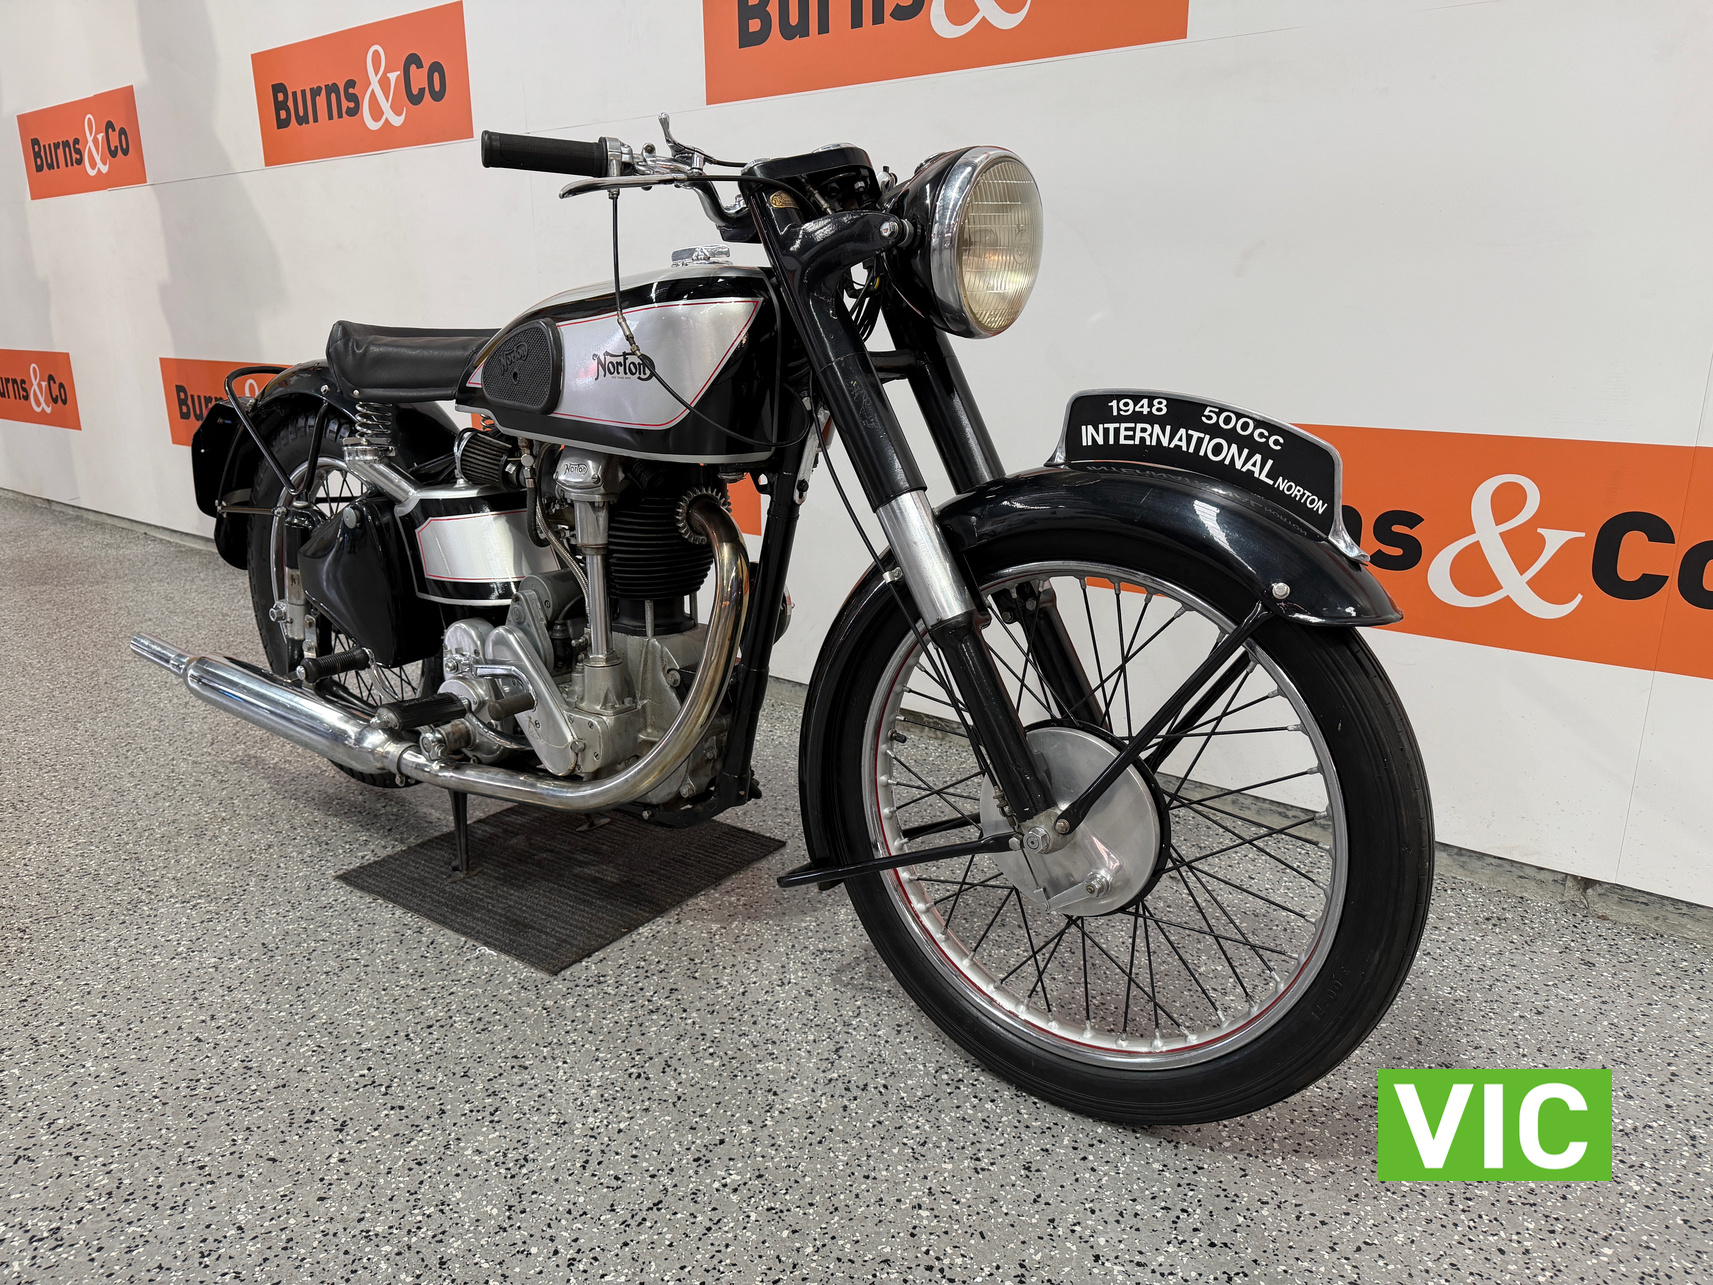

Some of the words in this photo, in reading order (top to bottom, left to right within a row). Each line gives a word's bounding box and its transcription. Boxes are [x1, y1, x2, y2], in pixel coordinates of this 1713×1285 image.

[271, 44, 447, 131] Burns&Co
[30, 113, 130, 176] Burns&Co
[592, 350, 655, 381] Norton
[1108, 398, 1168, 416] 1948
[1201, 406, 1285, 450] 500cc
[564, 463, 588, 476] Norton
[1081, 423, 1274, 485] INTERNATIONAL
[1274, 478, 1328, 515] NORTON
